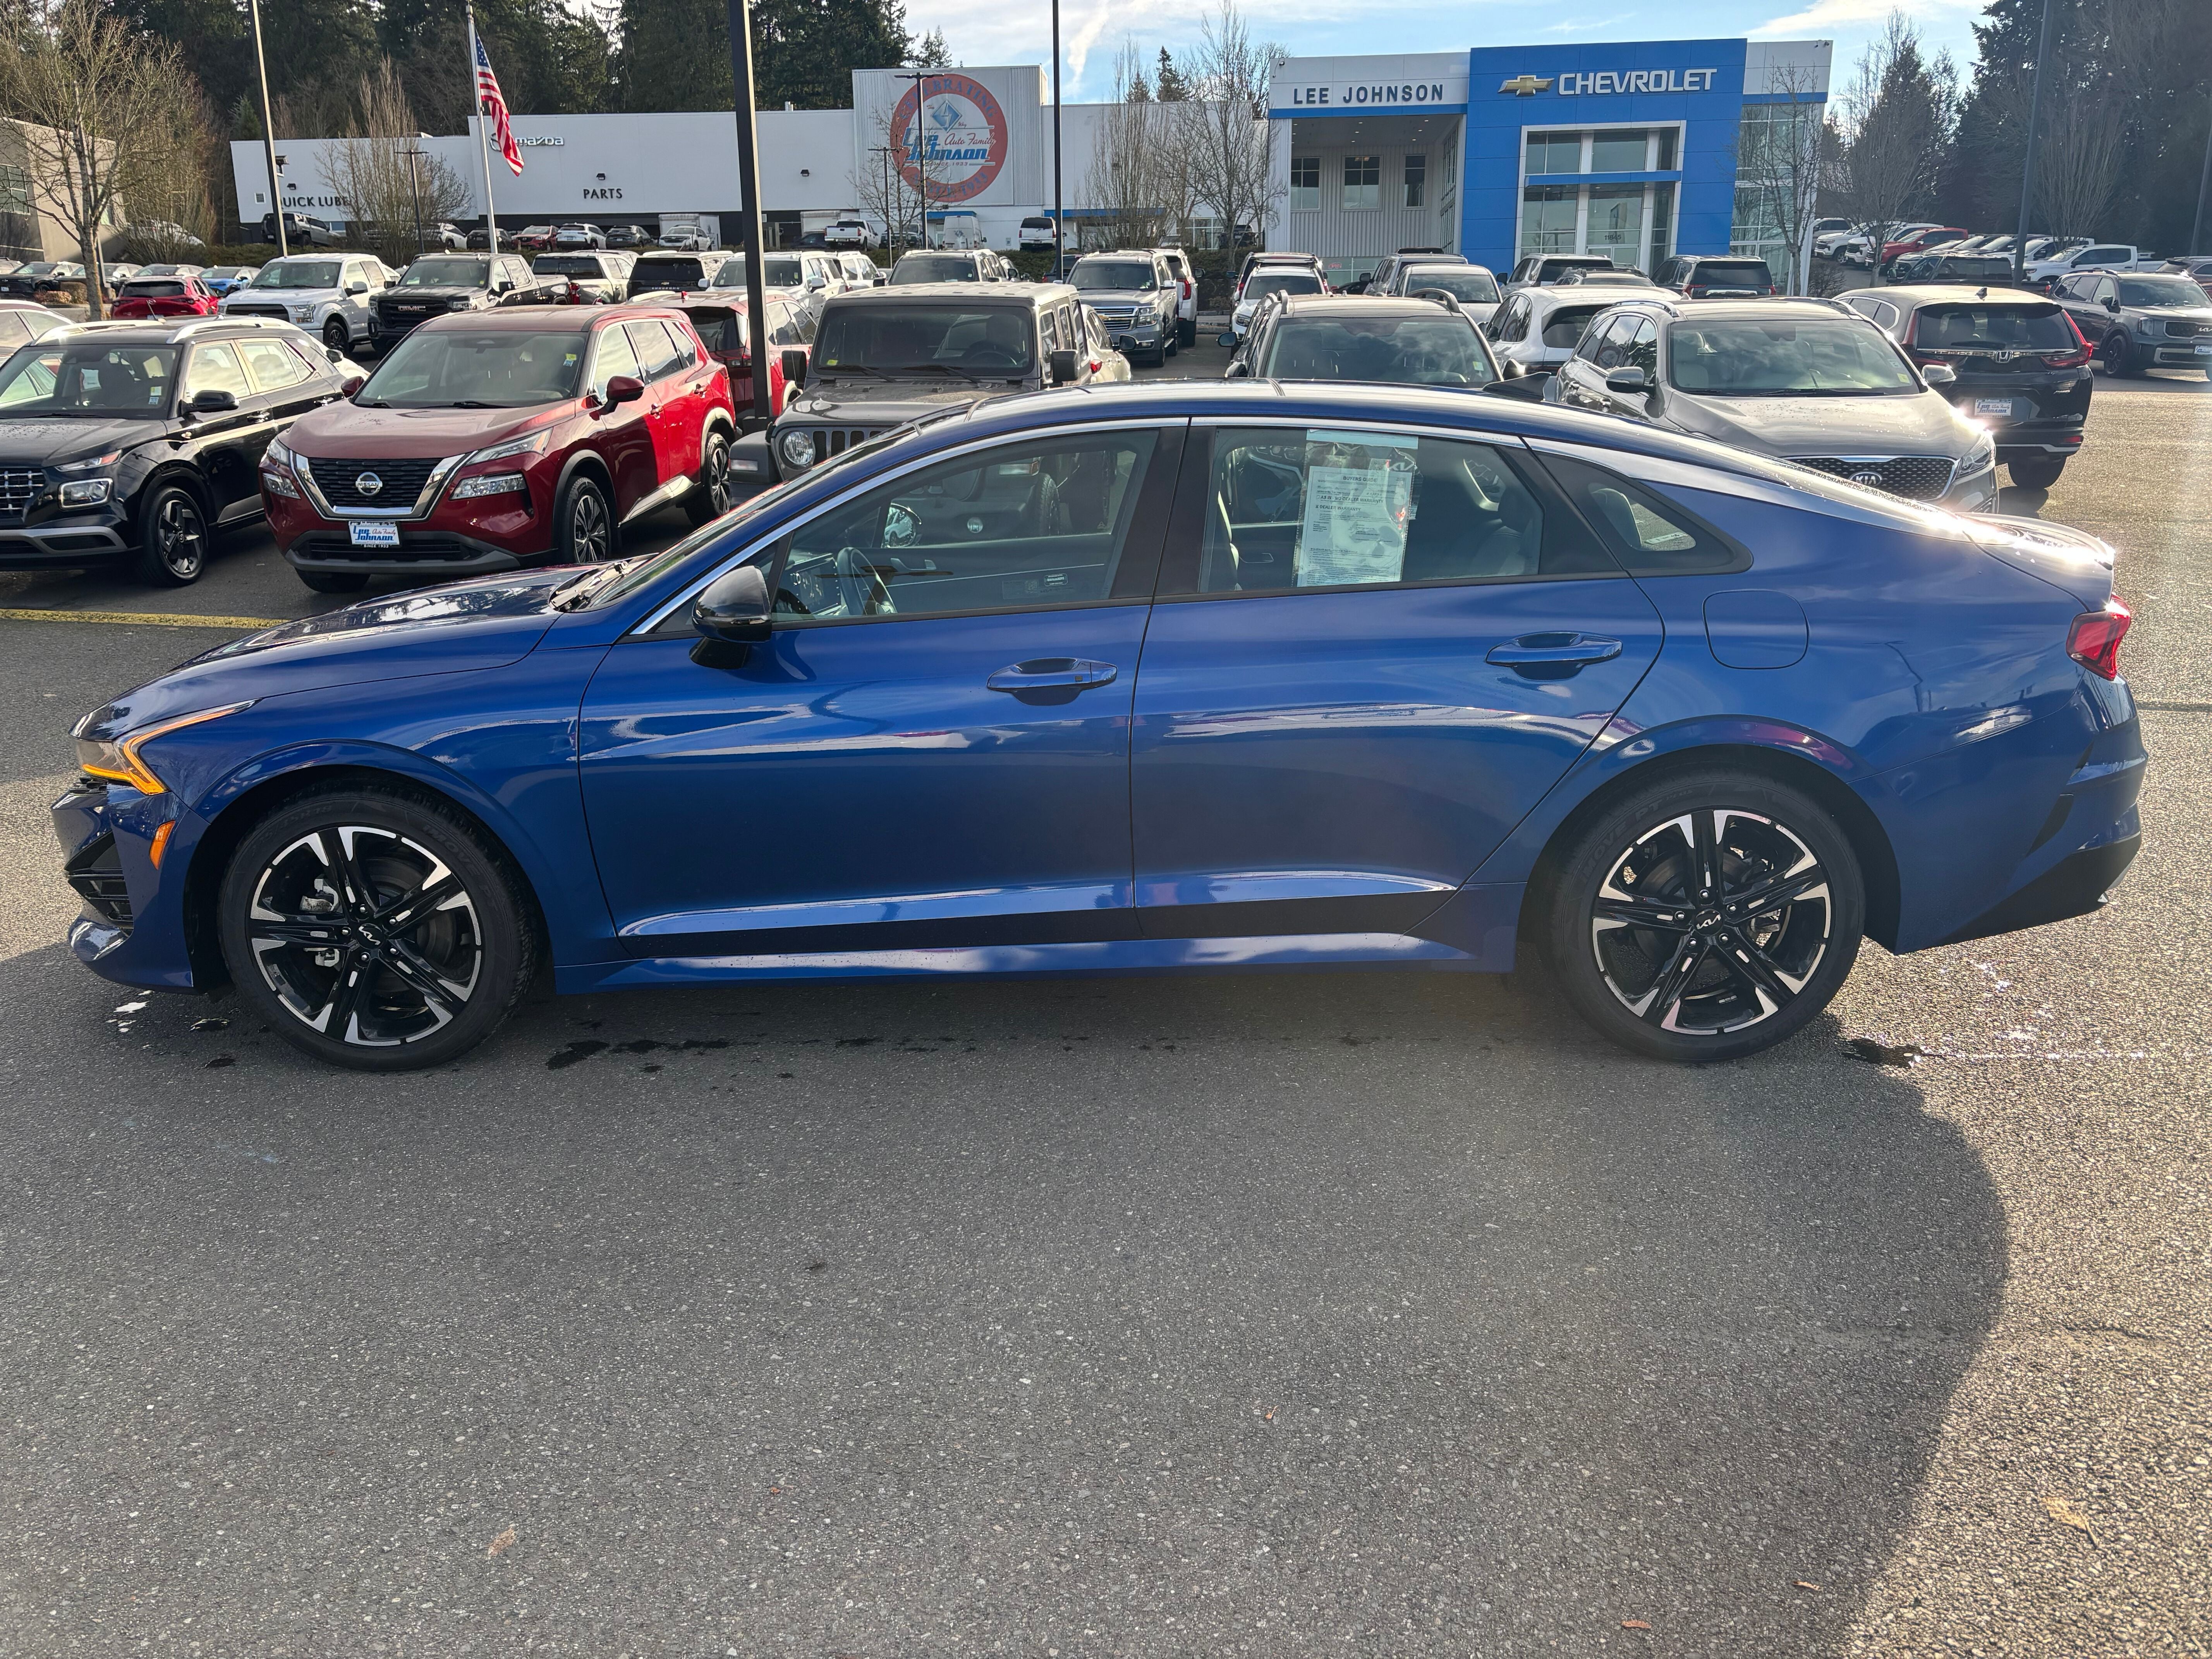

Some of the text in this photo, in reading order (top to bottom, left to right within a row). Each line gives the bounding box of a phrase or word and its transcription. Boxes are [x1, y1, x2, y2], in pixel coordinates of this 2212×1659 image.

[1559, 69, 1717, 95] CHEVROLET
[1294, 84, 1443, 105] LEE JOHNSON
[515, 136, 564, 146] mazda
[945, 132, 996, 150] Auto Family
[583, 188, 623, 199] PARTS
[281, 196, 316, 209] UICK
[1855, 476, 1877, 485] KIA
[353, 526, 371, 534] Lee
[355, 533, 394, 541] Johnson
